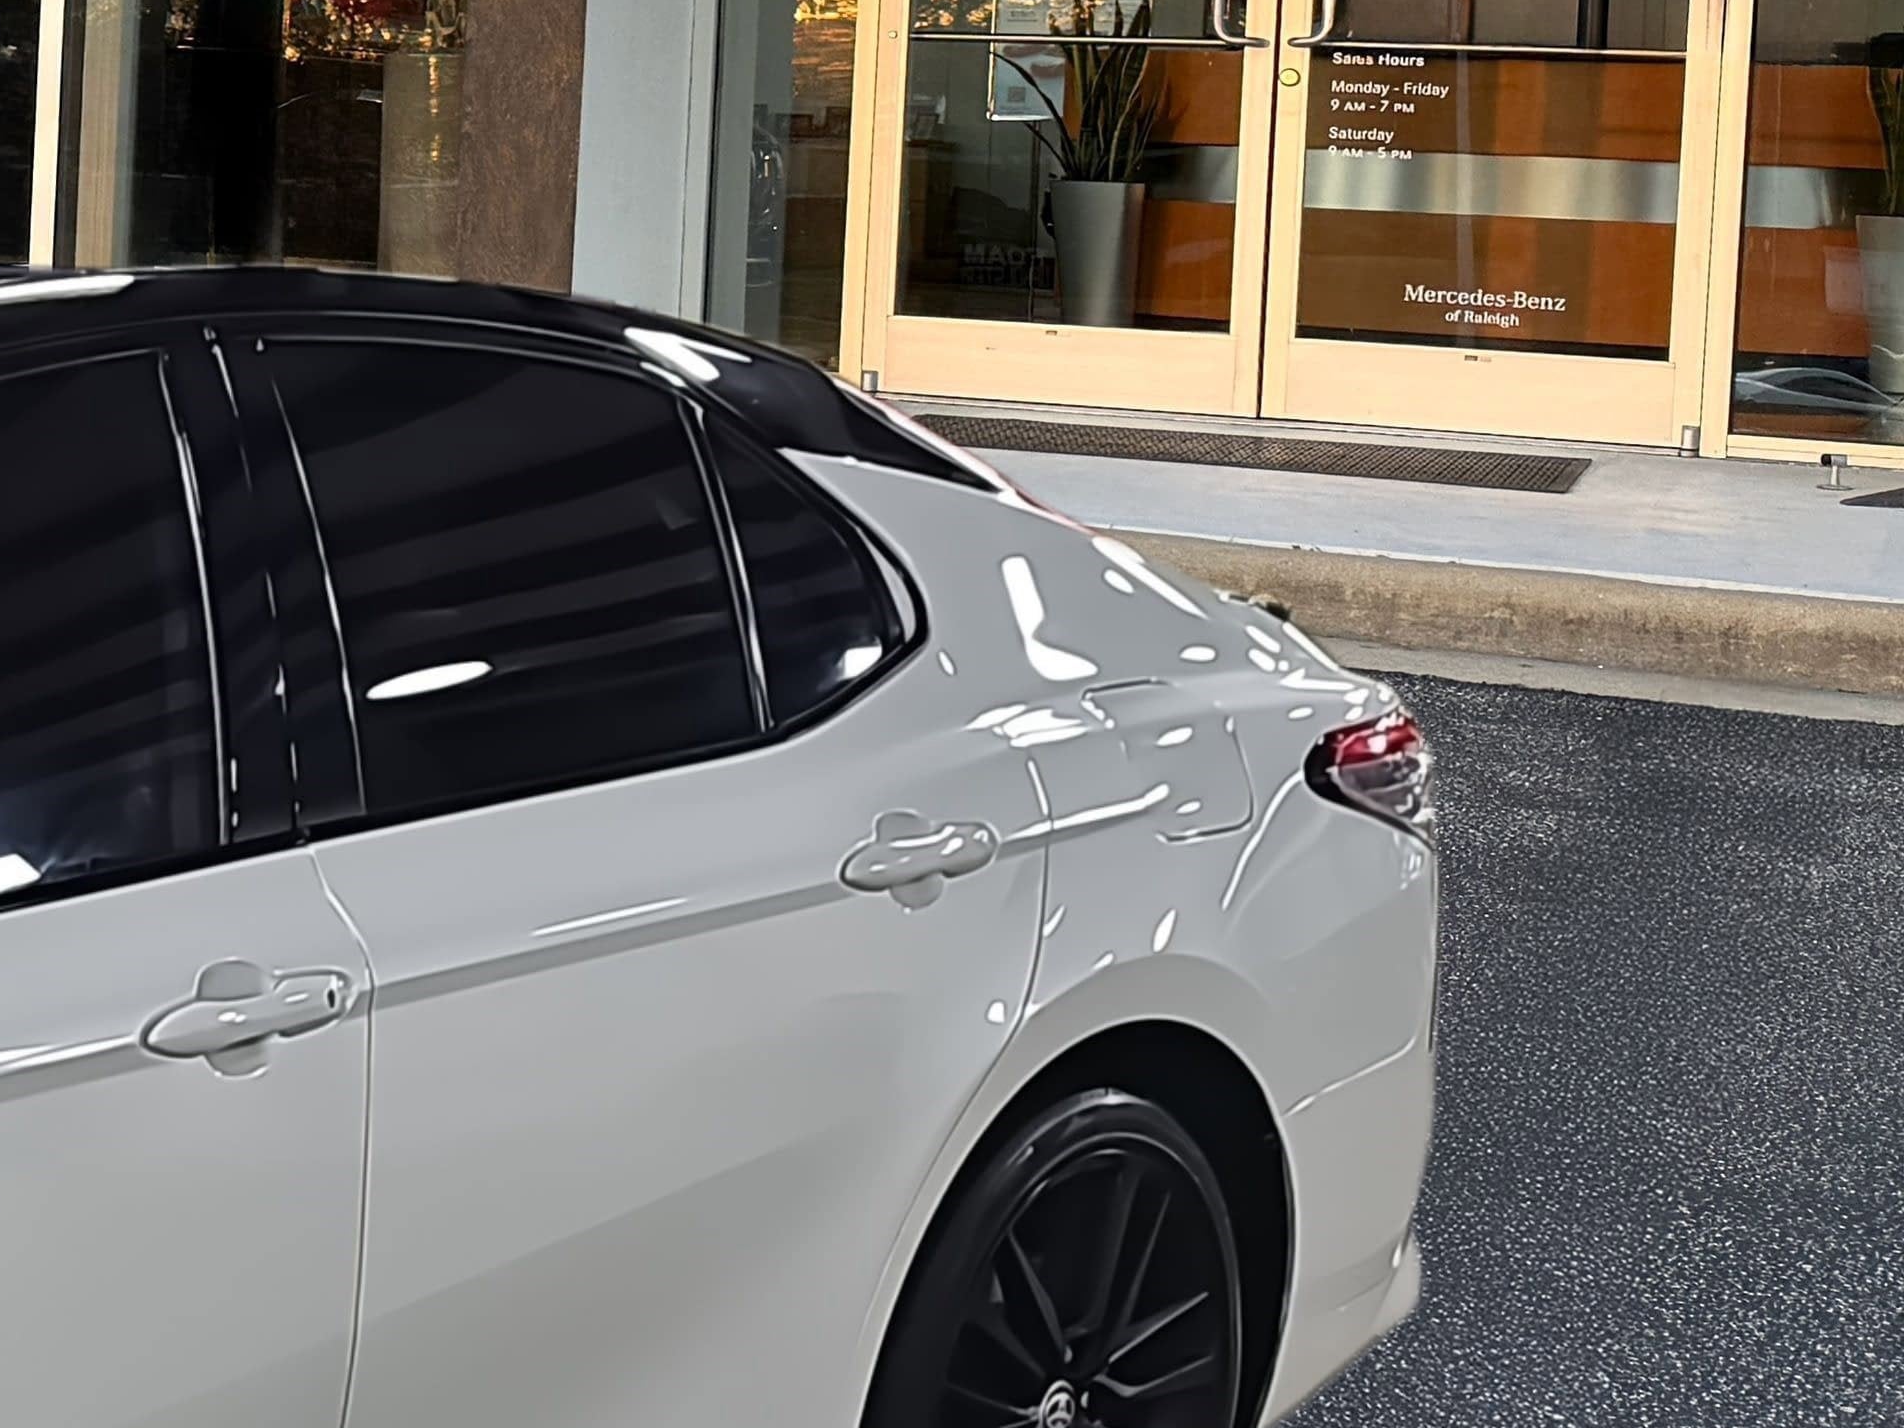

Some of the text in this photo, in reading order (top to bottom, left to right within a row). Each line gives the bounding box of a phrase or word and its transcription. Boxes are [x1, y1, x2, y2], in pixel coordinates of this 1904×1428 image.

[1378, 53, 1425, 67] Hours
[1331, 79, 1390, 98] Monday
[1403, 81, 1450, 99] Friday
[1330, 98, 1340, 112] 9
[1343, 101, 1366, 112] AM
[1379, 100, 1390, 113] 7
[1393, 103, 1415, 114] PM
[1328, 126, 1394, 144] Saturday
[1328, 145, 1337, 157] 9
[1342, 147, 1364, 158] AM
[1377, 146, 1387, 159] 5
[1391, 149, 1413, 160] PM
[1403, 283, 1566, 312] Mercedes-Benz
[1445, 309, 1520, 329] of Raleigh
